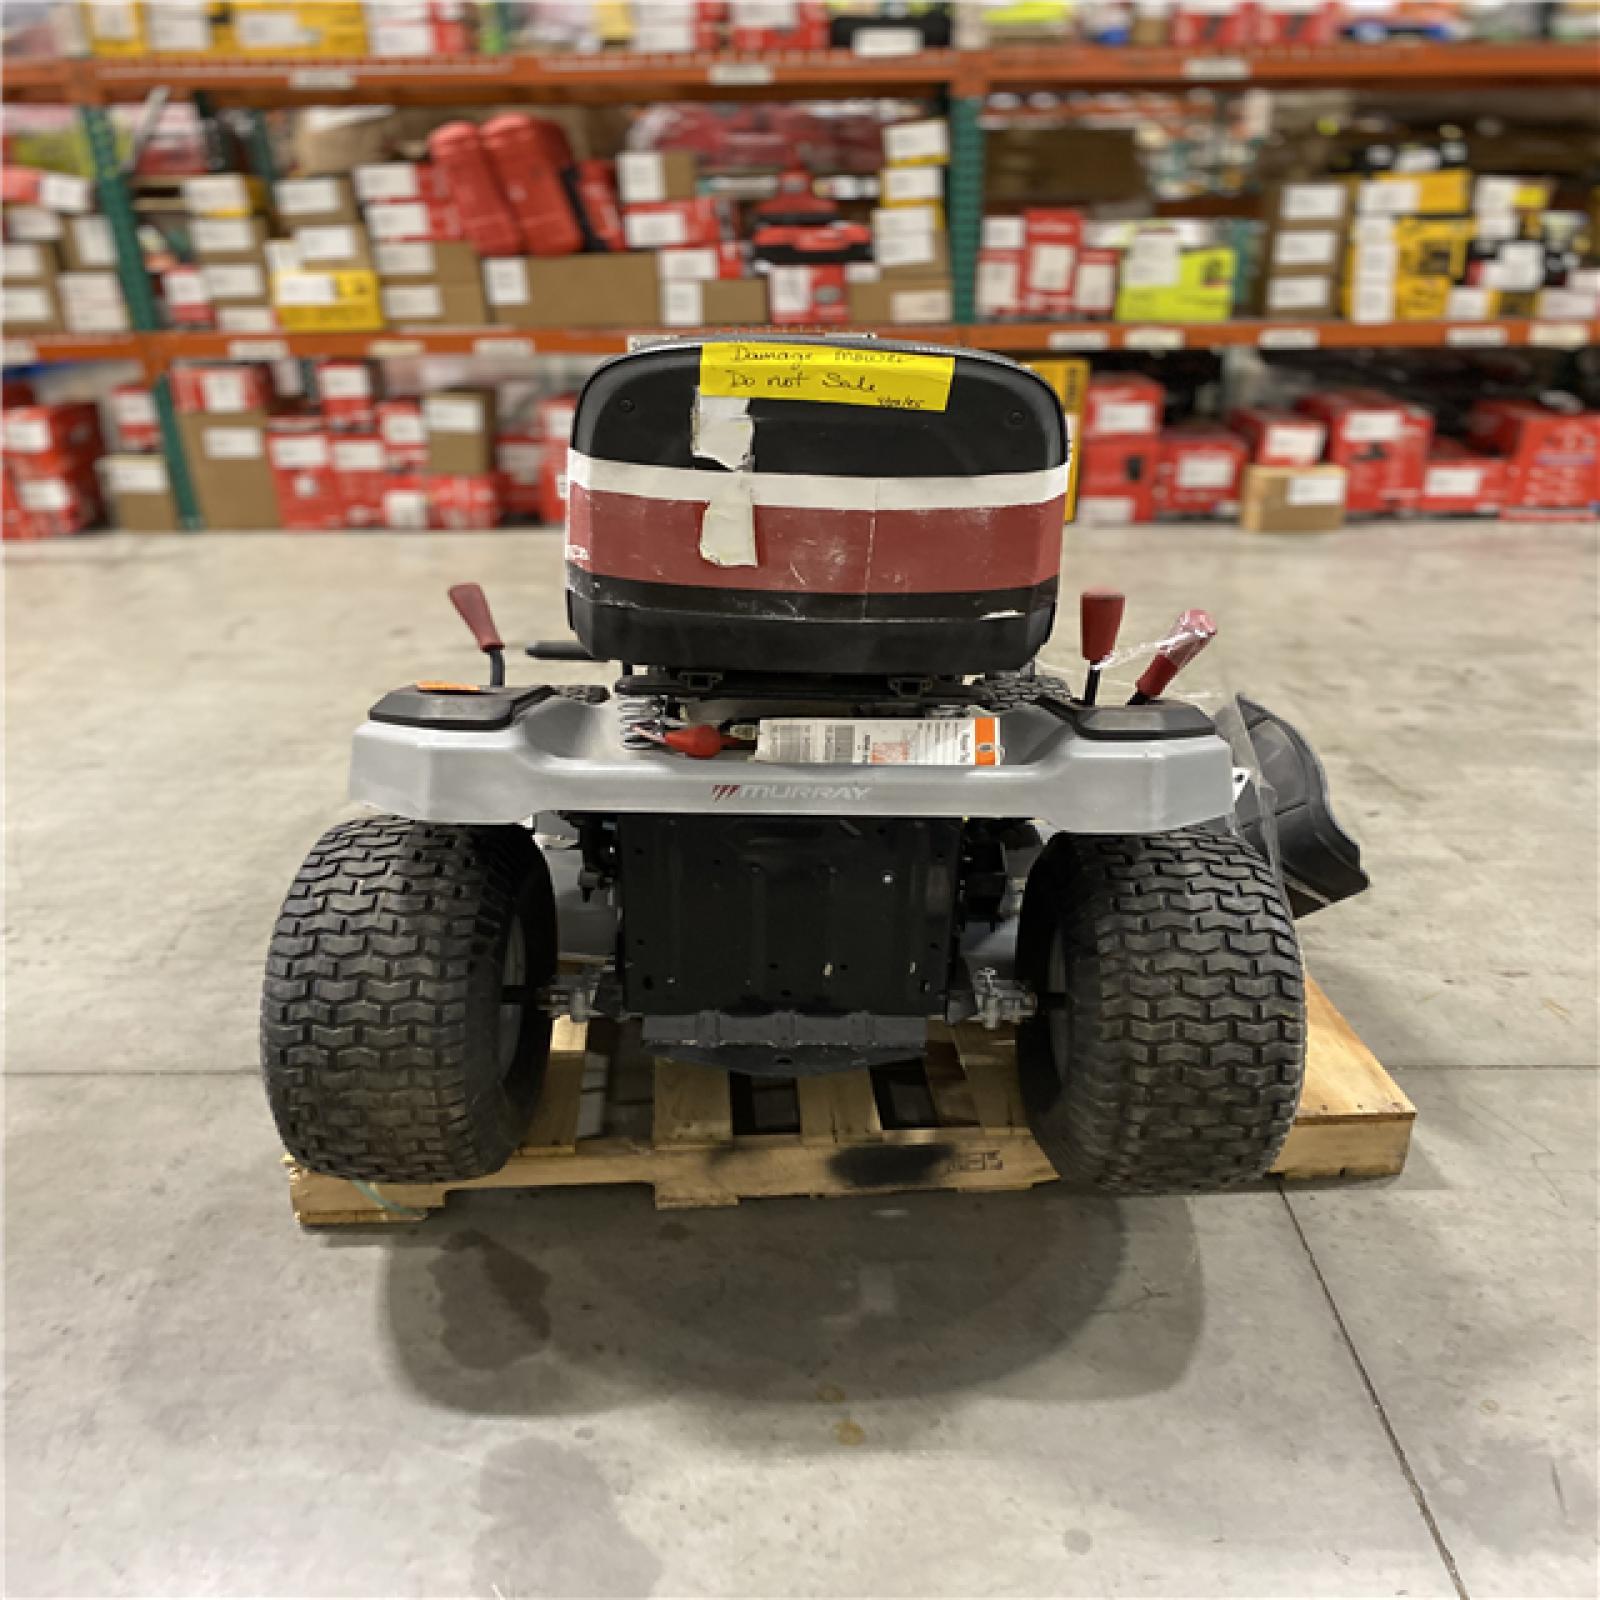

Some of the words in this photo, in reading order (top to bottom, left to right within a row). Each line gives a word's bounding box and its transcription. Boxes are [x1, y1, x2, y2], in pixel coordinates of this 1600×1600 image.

[725, 369, 756, 388] Do
[767, 370, 810, 388] not
[740, 785, 872, 801] MURRAY
